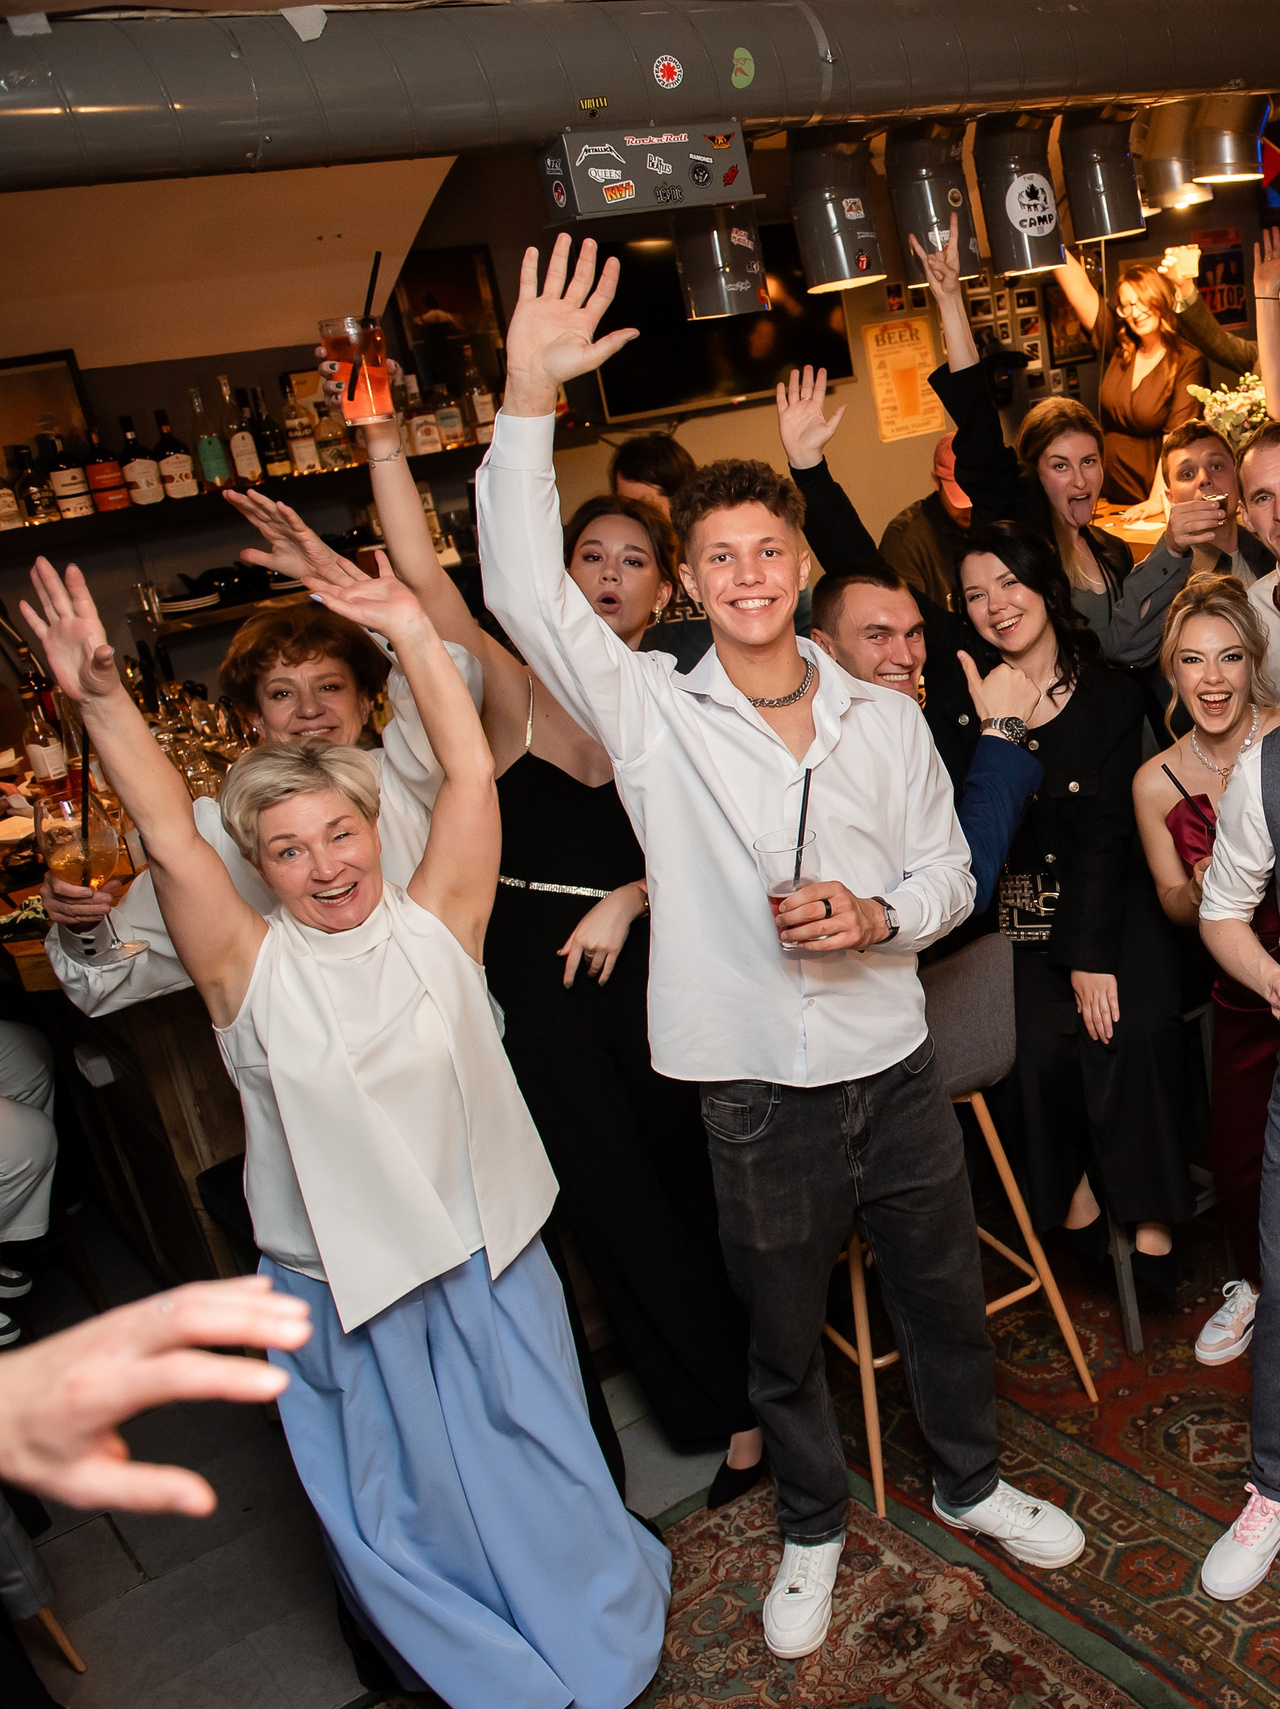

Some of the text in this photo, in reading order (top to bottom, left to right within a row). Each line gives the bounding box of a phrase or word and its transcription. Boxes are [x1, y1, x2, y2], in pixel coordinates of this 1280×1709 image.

[580, 97, 608, 110] NIRVANA
[588, 168, 621, 182] QUEEN
[604, 182, 634, 202] KISS
[1019, 214, 1054, 228] CAMP
[1219, 286, 1244, 309] TOP
[875, 328, 920, 347] BEER
